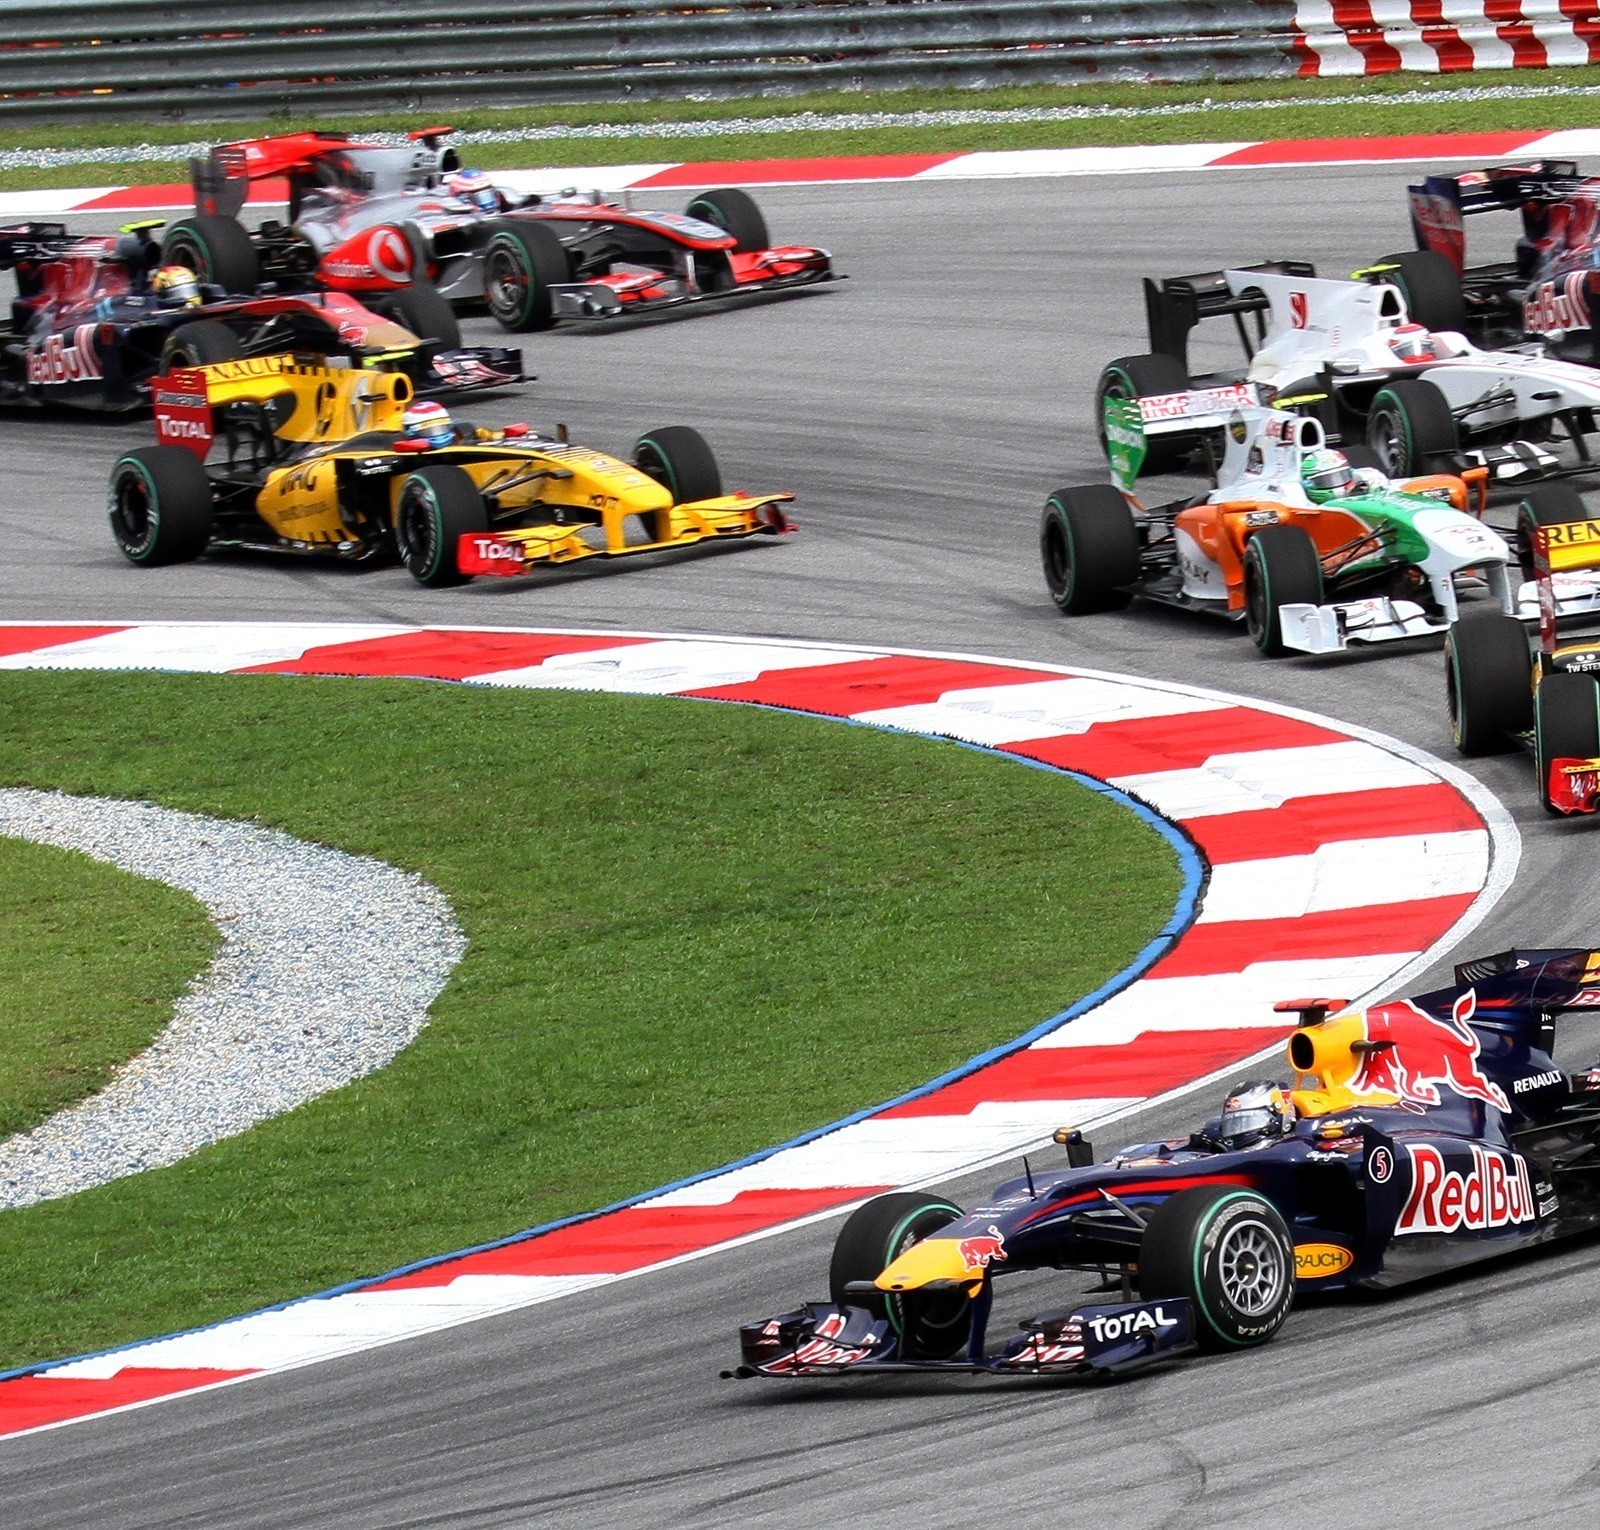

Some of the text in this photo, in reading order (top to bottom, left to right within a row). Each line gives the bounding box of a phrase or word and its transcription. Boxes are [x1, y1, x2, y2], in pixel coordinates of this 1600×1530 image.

[157, 414, 212, 440] TOTAL
[1513, 1069, 1563, 1094] RENAULT
[1088, 1307, 1178, 1343] TOTAL
